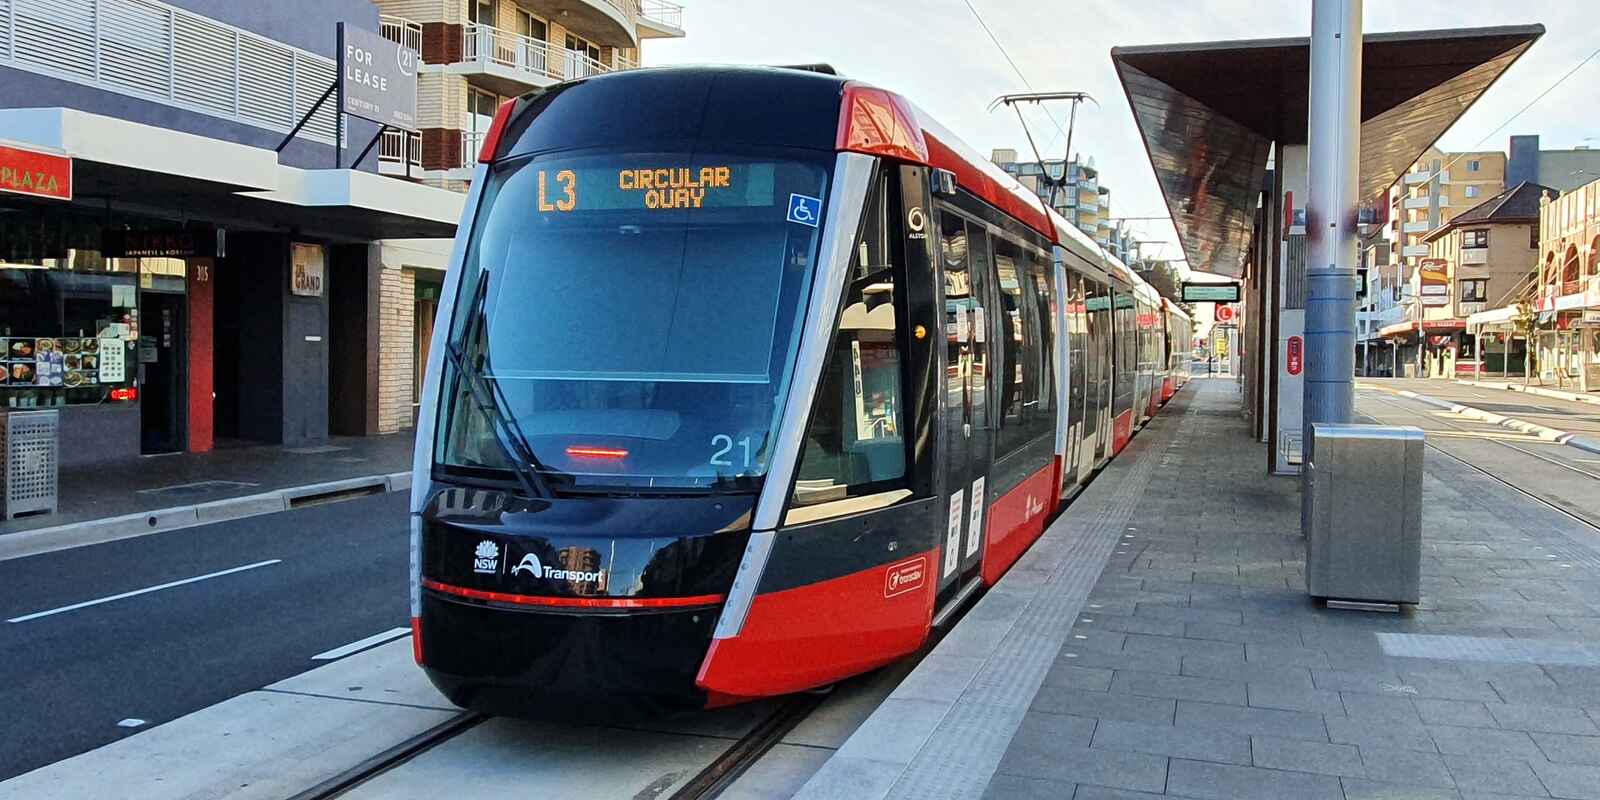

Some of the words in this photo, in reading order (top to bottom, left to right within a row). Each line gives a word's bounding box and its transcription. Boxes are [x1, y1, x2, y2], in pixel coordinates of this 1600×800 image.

[347, 45, 372, 66] FOR
[402, 50, 412, 67] 21
[347, 65, 387, 91] LEASE
[1, 167, 57, 192] PLAZA
[619, 167, 730, 190] CIRCULAR
[538, 170, 576, 211] L3
[645, 188, 705, 209] QUAY
[295, 272, 321, 290] GRAND
[710, 434, 750, 467] 21
[474, 558, 498, 570] NSW
[543, 565, 604, 583] Transport
